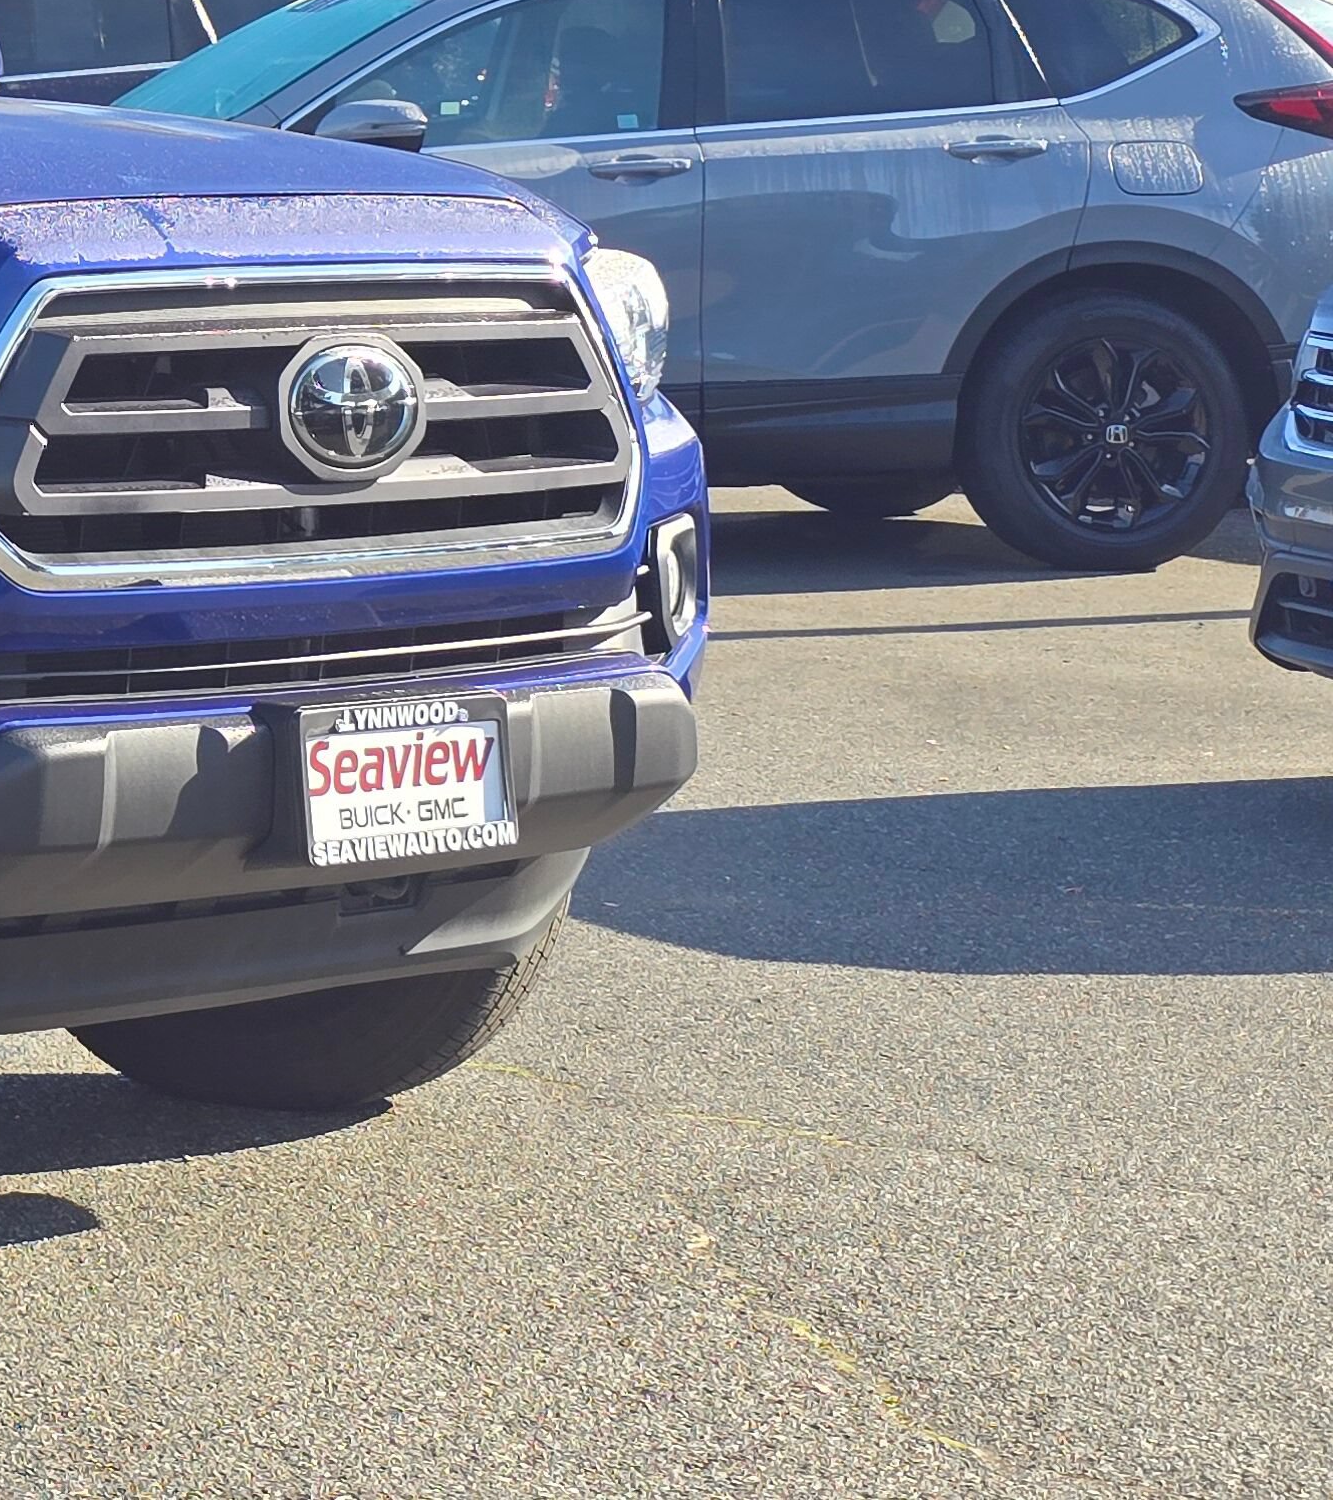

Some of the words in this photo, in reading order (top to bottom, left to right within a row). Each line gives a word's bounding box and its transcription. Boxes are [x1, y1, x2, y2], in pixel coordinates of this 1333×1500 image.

[339, 701, 460, 732] LYNNWOOD
[308, 731, 495, 798] Seaview
[339, 802, 406, 830] BUICK
[417, 796, 469, 823] GMC
[311, 821, 518, 867] SEAVIEWAUTO.COM
